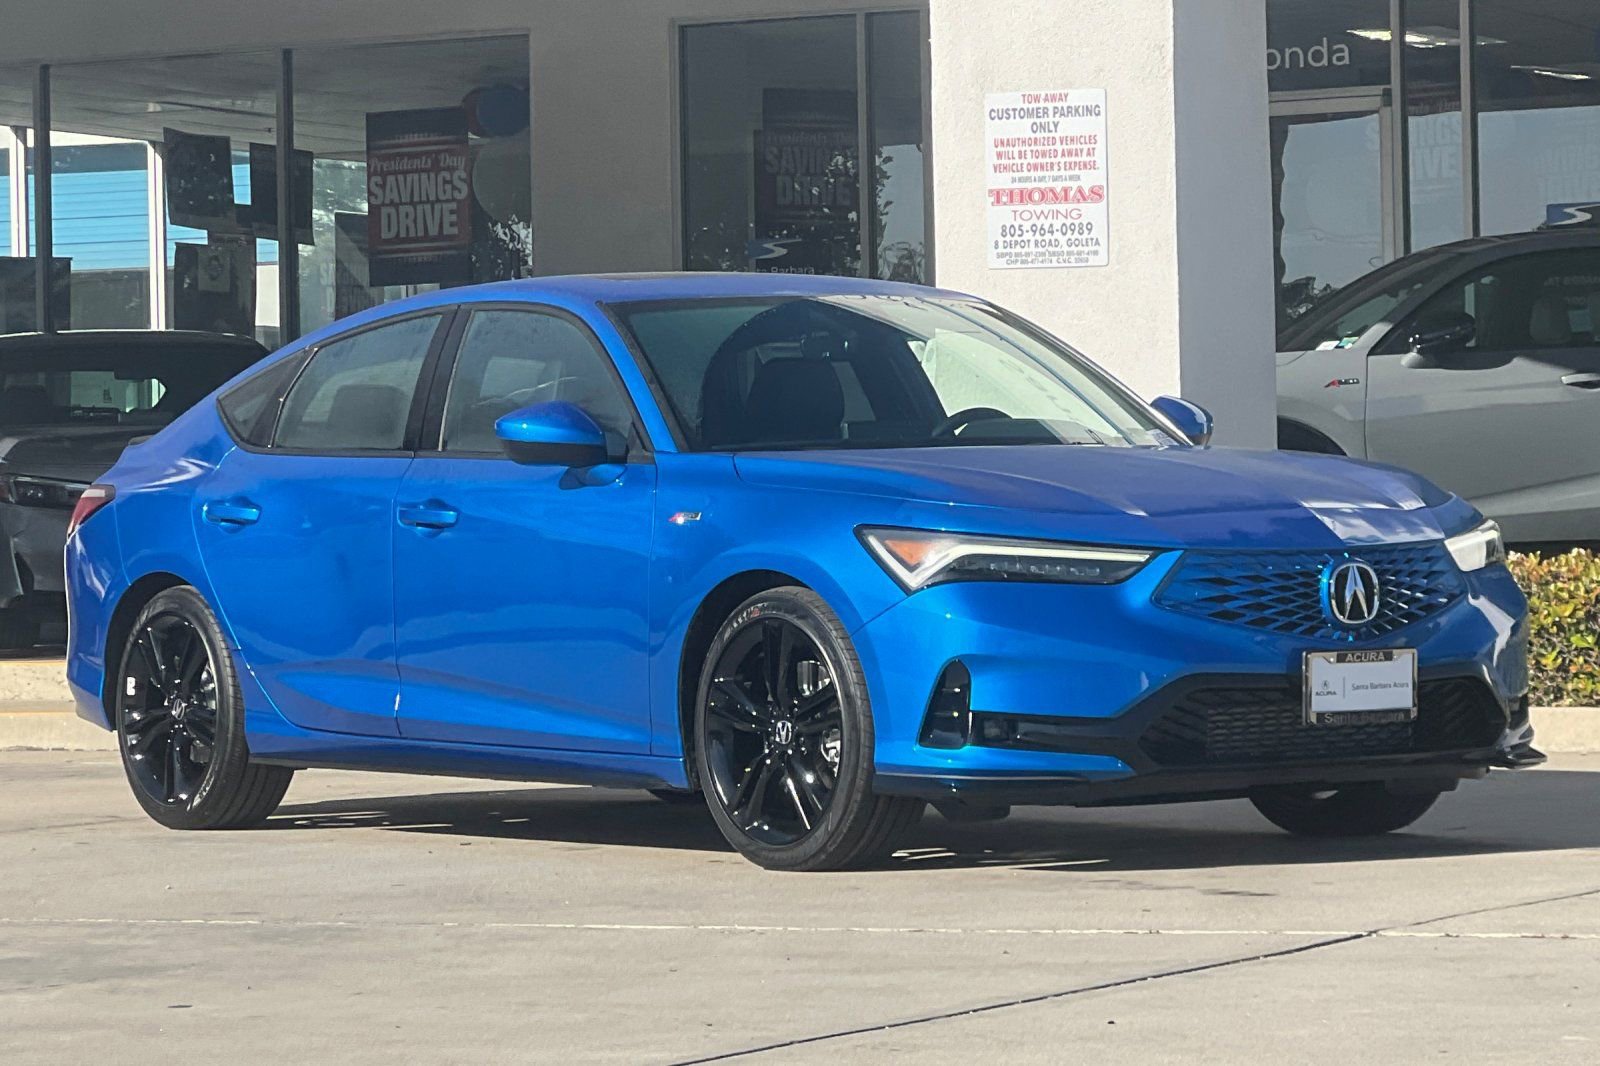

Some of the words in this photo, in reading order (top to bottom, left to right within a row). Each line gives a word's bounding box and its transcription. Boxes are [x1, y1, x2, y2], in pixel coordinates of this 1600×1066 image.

[1266, 36, 1350, 71] onda
[988, 106, 1050, 121] CUSTOMER
[1052, 104, 1102, 118] PARKING
[1030, 120, 1060, 134] ONLY
[993, 136, 1057, 149] UNAUTHORIZED
[1059, 134, 1098, 146] VEHICLES
[438, 152, 466, 170] Day
[996, 150, 1016, 161] WILL
[1018, 149, 1028, 160] BE
[1029, 148, 1059, 159] TOWED
[1060, 147, 1084, 159] AWAY
[1085, 147, 1096, 158] AT
[992, 162, 1024, 174] VEHICLE
[1026, 161, 1062, 172] OWNER'S
[1063, 160, 1100, 171] EXPENSE.
[369, 170, 468, 205] SAVINGS
[988, 185, 1105, 206] THOMAS
[381, 201, 459, 239] DRIVE
[1011, 208, 1083, 221] TOWING
[1000, 222, 1093, 238] 805-964-0989
[994, 240, 999, 250] 8
[1002, 239, 1032, 249] DEPOT
[1034, 238, 1063, 249] ROAD,
[1066, 237, 1101, 248] GOLETA
[1345, 652, 1385, 662] ACURA
